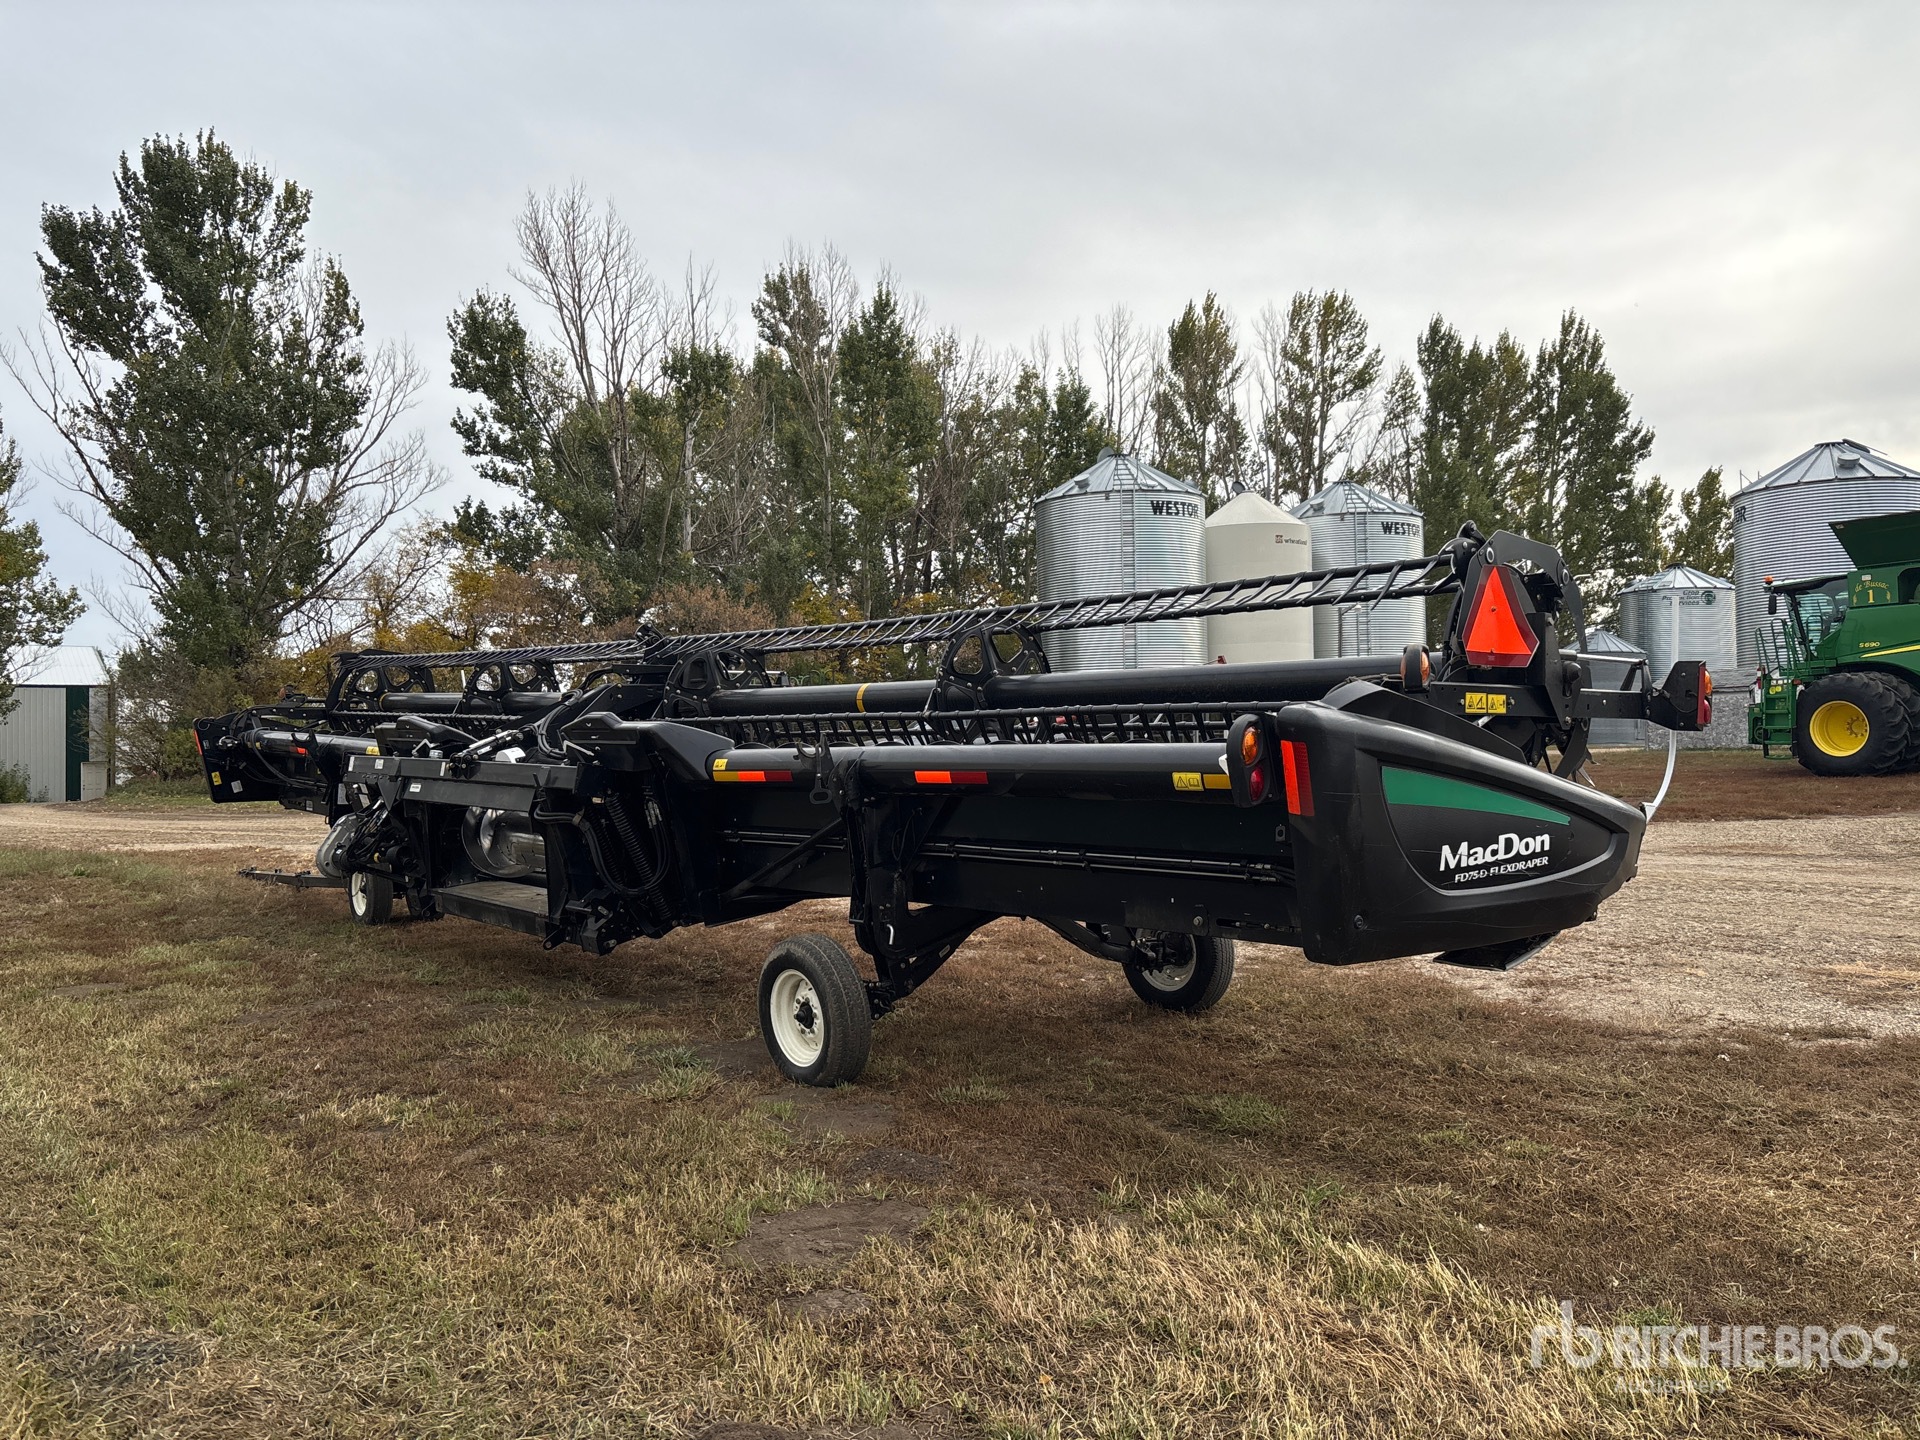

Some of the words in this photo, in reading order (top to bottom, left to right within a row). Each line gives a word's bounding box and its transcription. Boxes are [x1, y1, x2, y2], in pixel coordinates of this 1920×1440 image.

[1150, 500, 1199, 518] WESTOR
[1867, 589, 1875, 604] 1
[1439, 832, 1550, 872] MacDon
